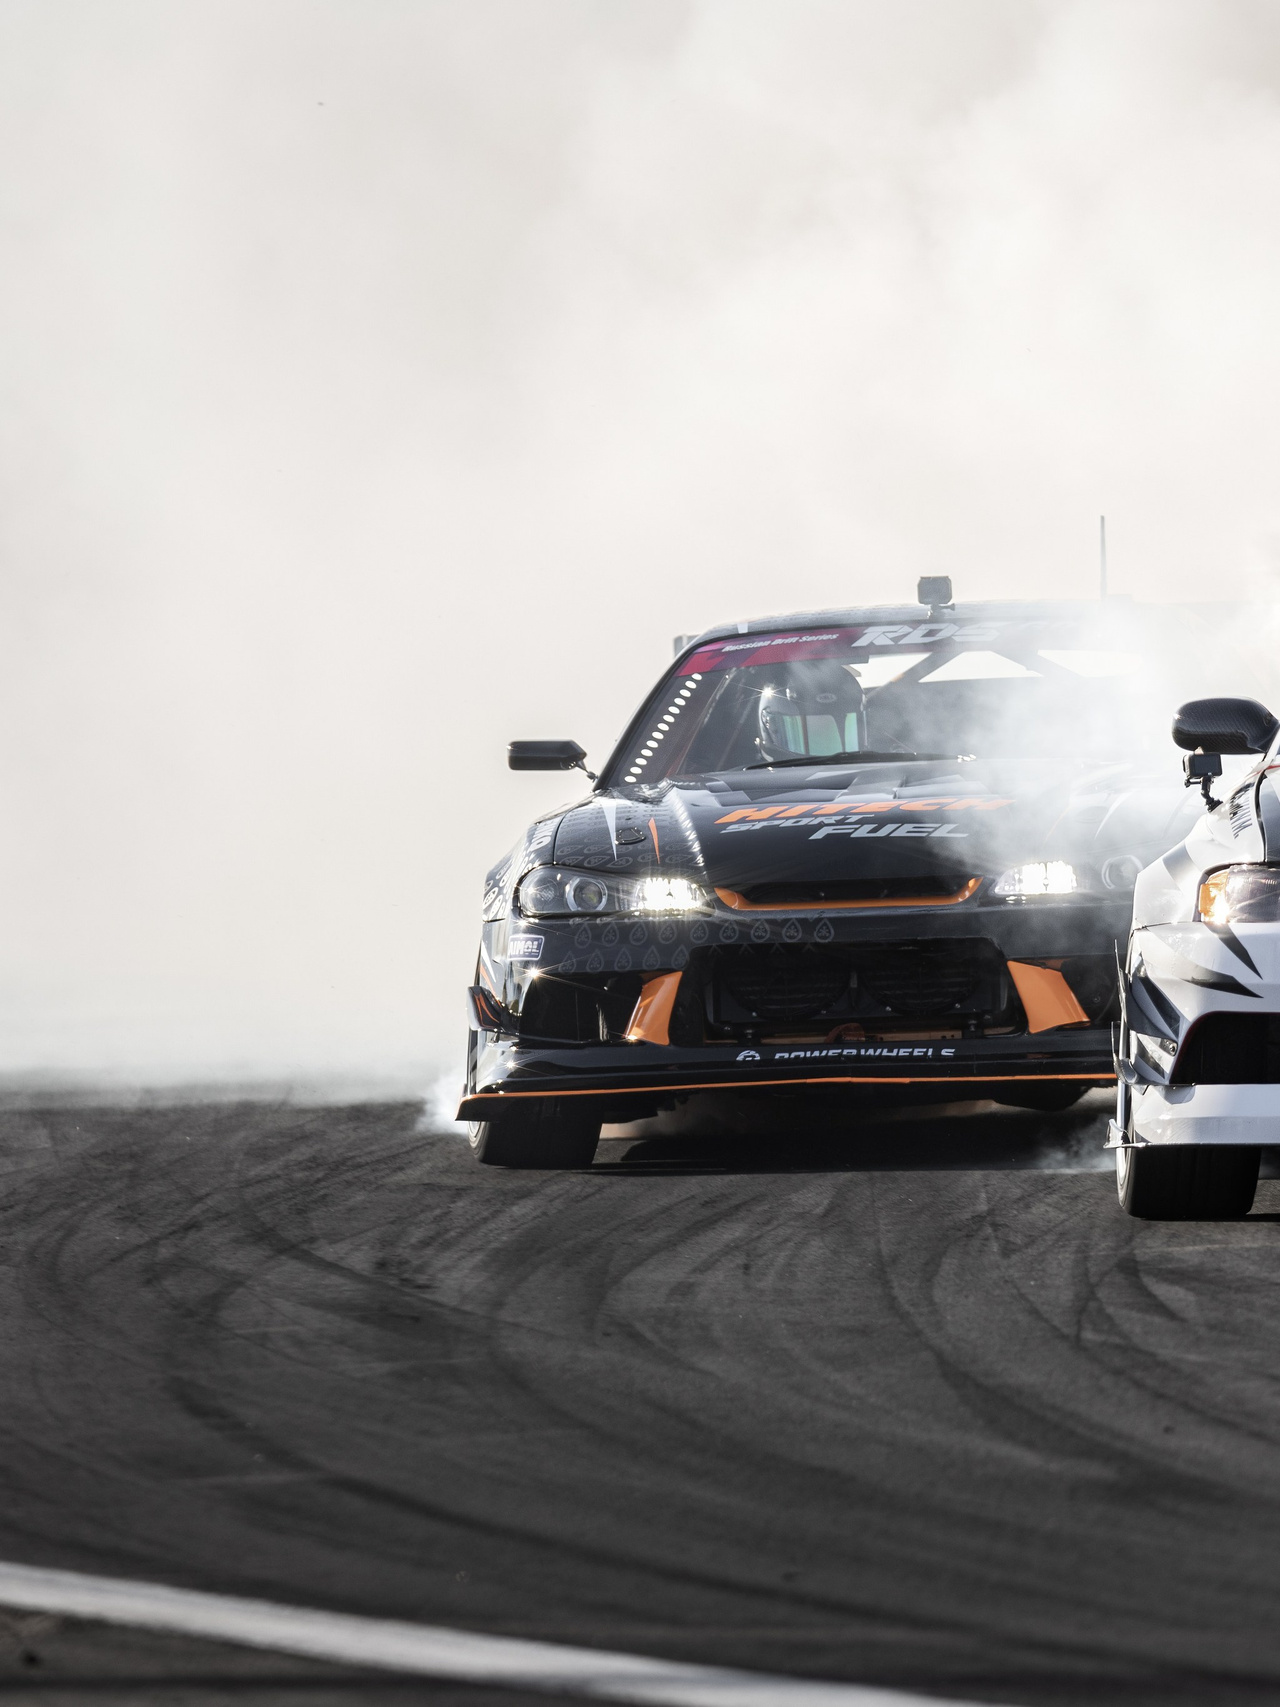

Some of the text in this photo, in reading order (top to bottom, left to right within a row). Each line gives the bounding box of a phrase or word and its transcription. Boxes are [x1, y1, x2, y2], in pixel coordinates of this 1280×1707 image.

[721, 633, 840, 652] Russian Drift Series
[851, 622, 1013, 647] RDS
[714, 798, 1016, 824] HITECH
[720, 814, 875, 834] SPORT
[808, 823, 969, 840] FUEL
